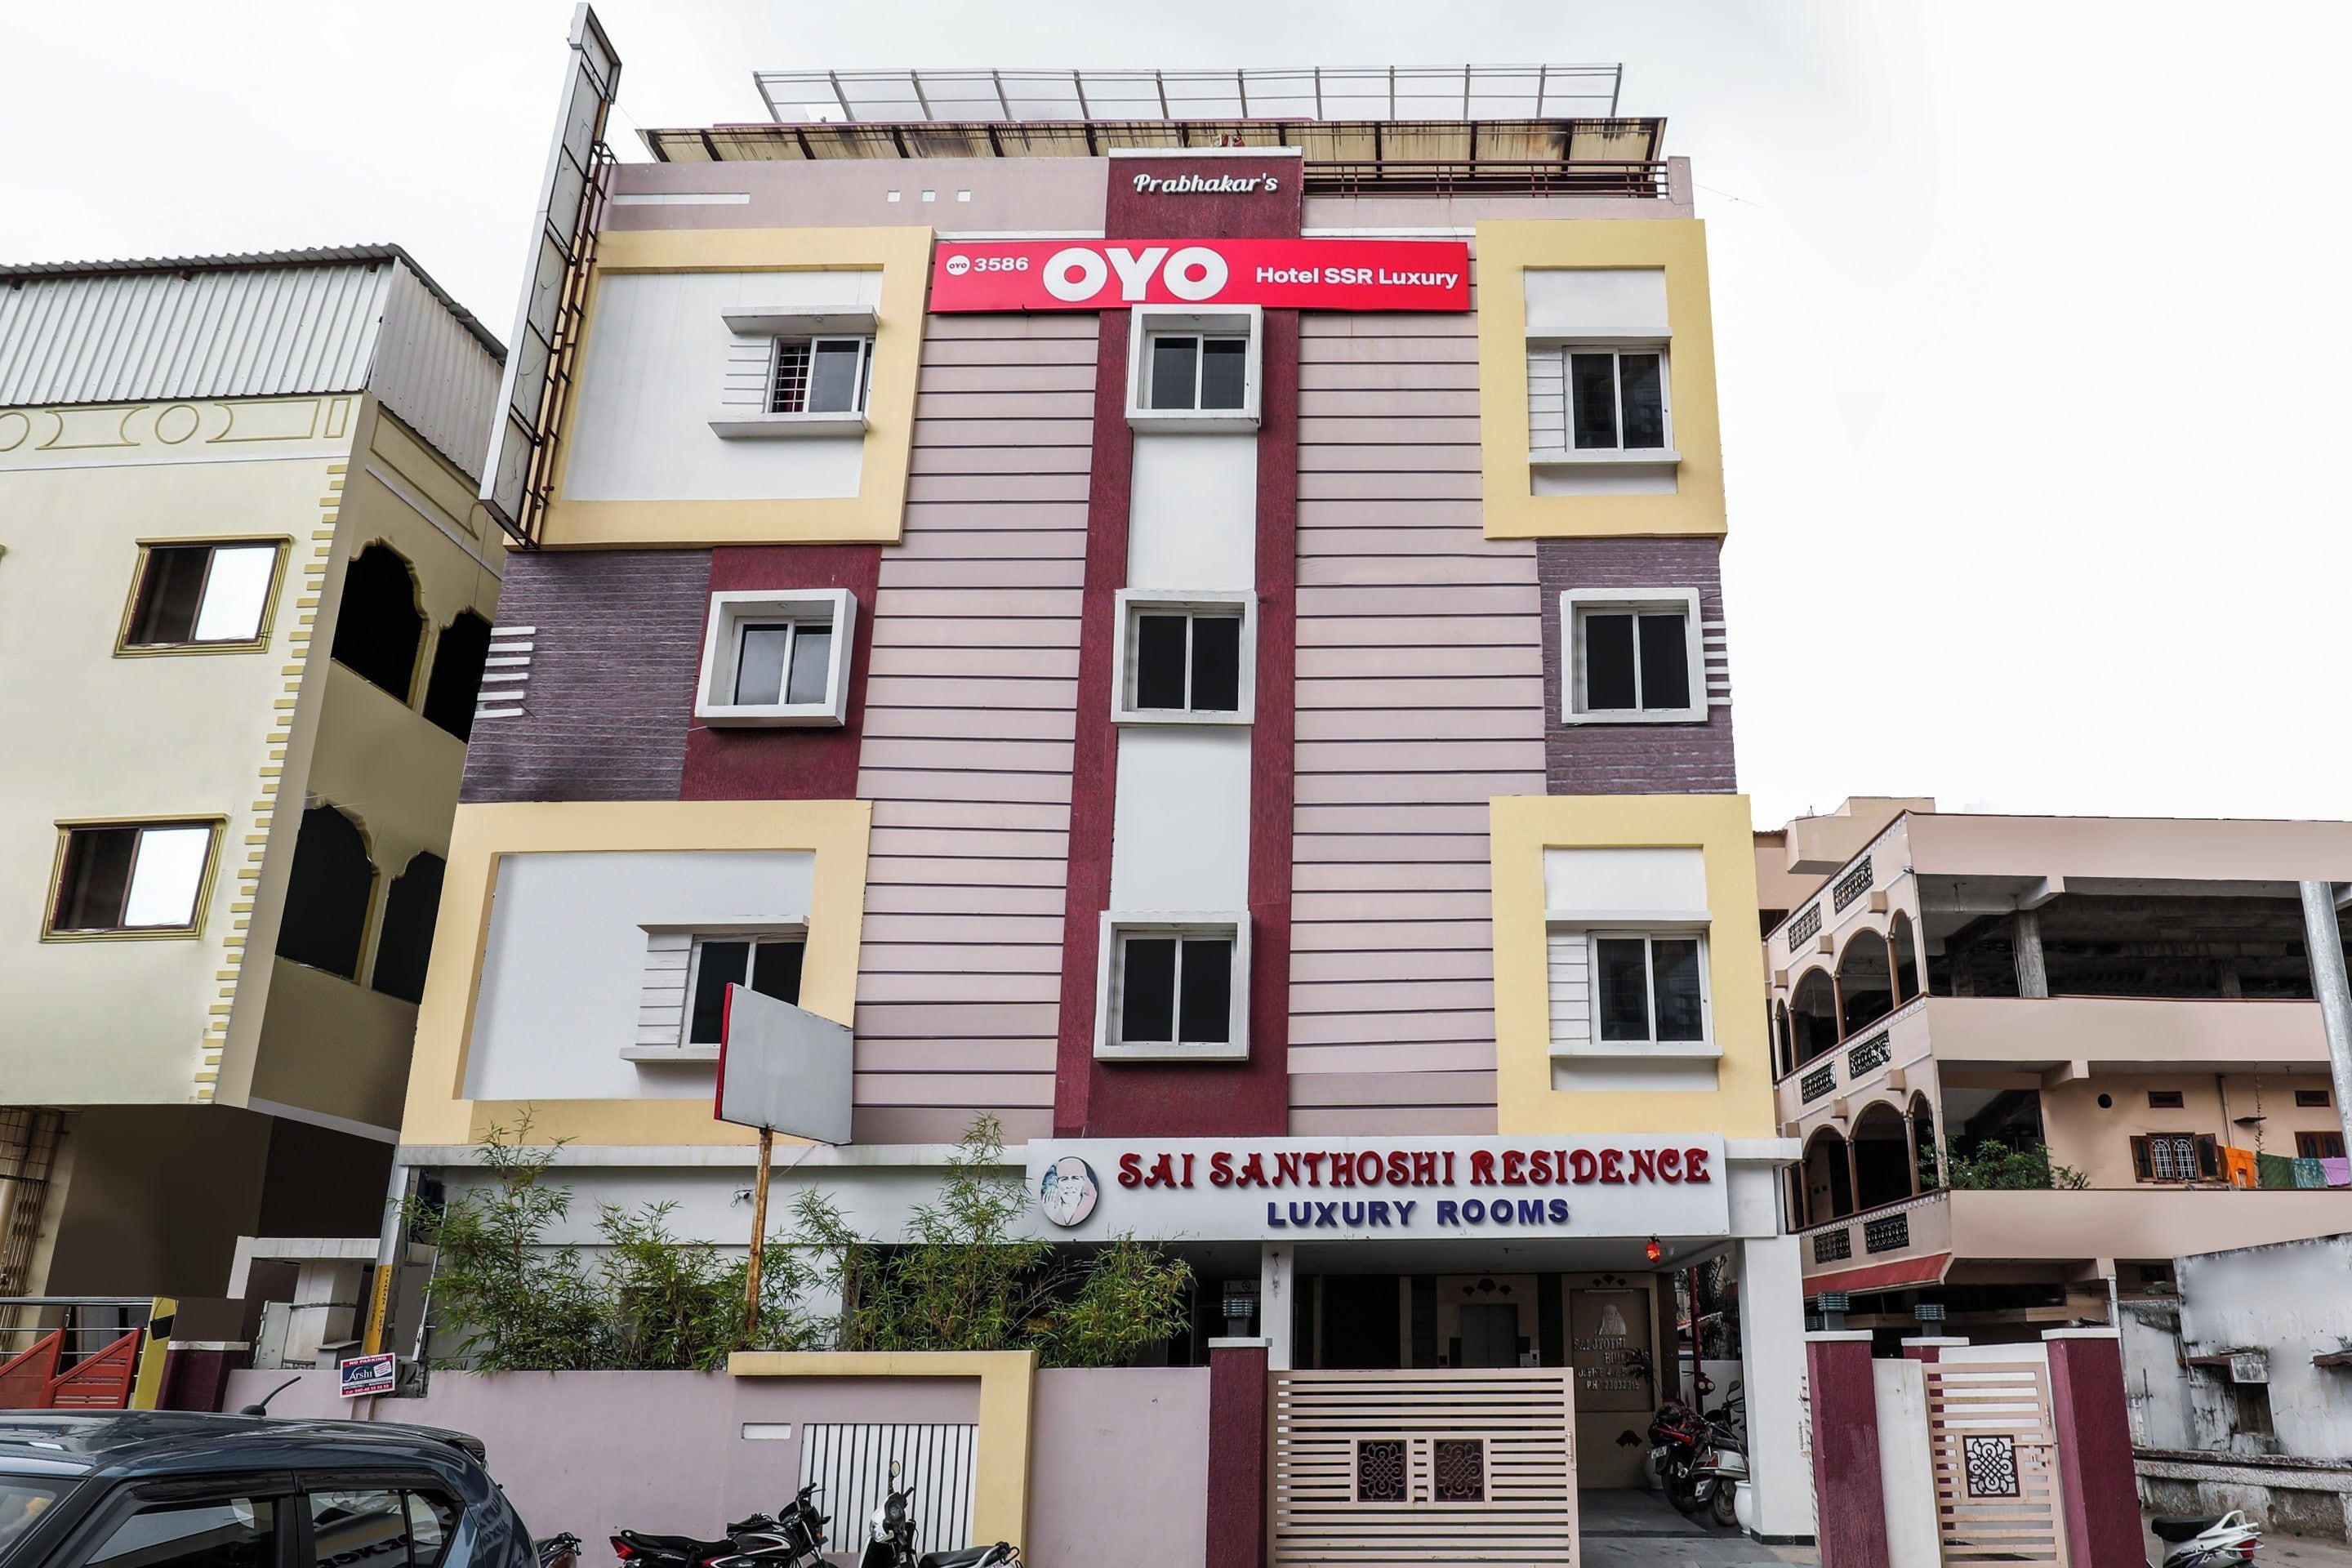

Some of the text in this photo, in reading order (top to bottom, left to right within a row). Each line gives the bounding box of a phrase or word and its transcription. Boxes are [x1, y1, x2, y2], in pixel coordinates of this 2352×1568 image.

[1133, 172, 1279, 193] Prabhakar's
[949, 256, 1029, 272] OYO 3586
[1042, 247, 1228, 302] OYO
[1256, 266, 1459, 289] Hotel SSR Luxury
[1117, 1147, 1712, 1187] SAI SANTHOSHI RESIDENCE
[1267, 1198, 1570, 1226] LUXURY ROOMS
[344, 1365, 372, 1383] Arshi
